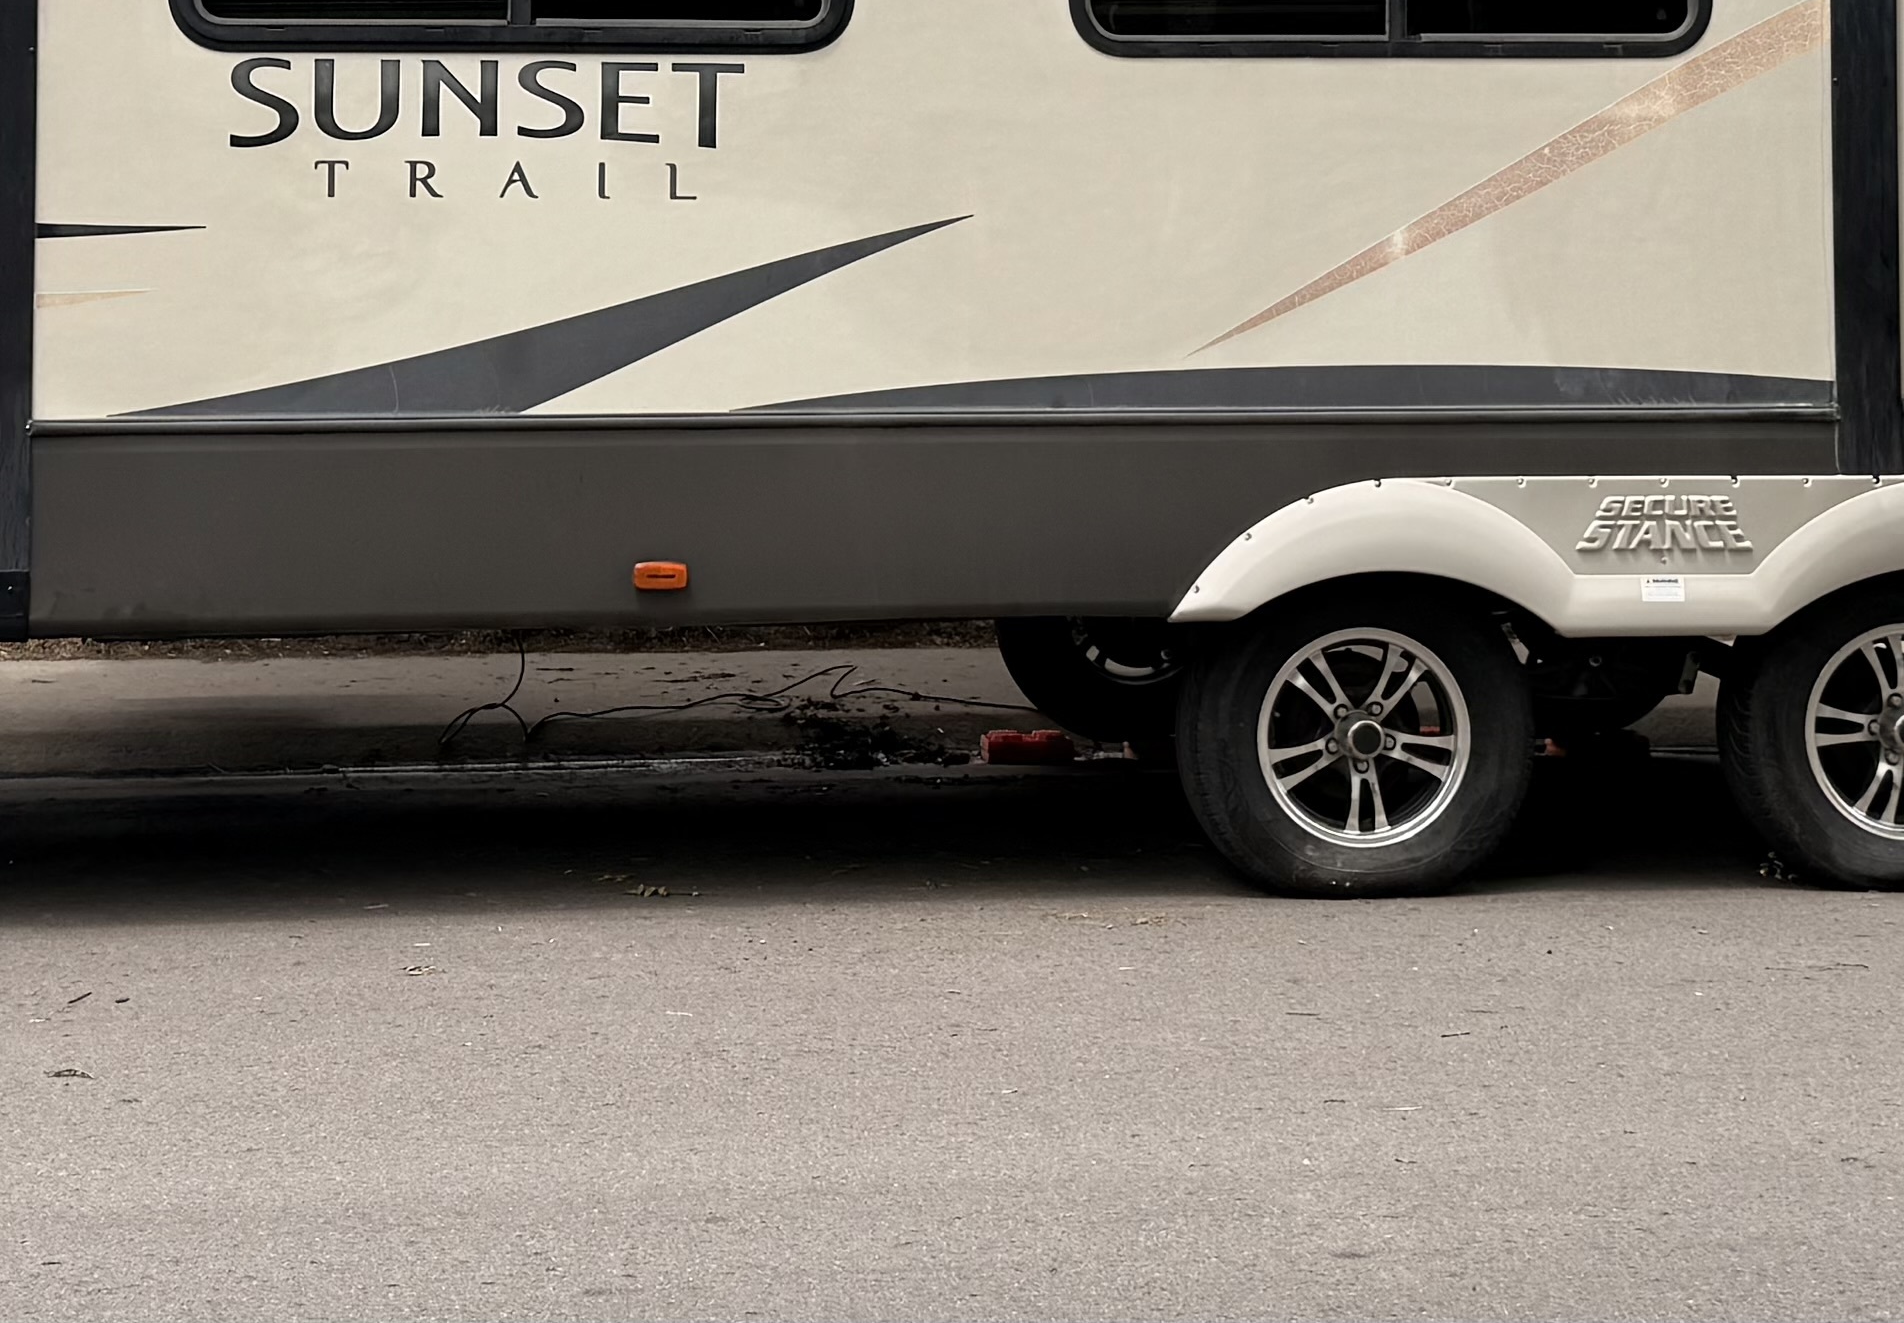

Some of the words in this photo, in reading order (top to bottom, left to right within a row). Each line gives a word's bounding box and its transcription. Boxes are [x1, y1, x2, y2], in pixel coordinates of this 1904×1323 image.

[229, 57, 745, 149] SUNSET
[314, 160, 697, 200] TRAIL
[1596, 494, 1737, 517] SECURE
[1575, 520, 1753, 551] STANCE
